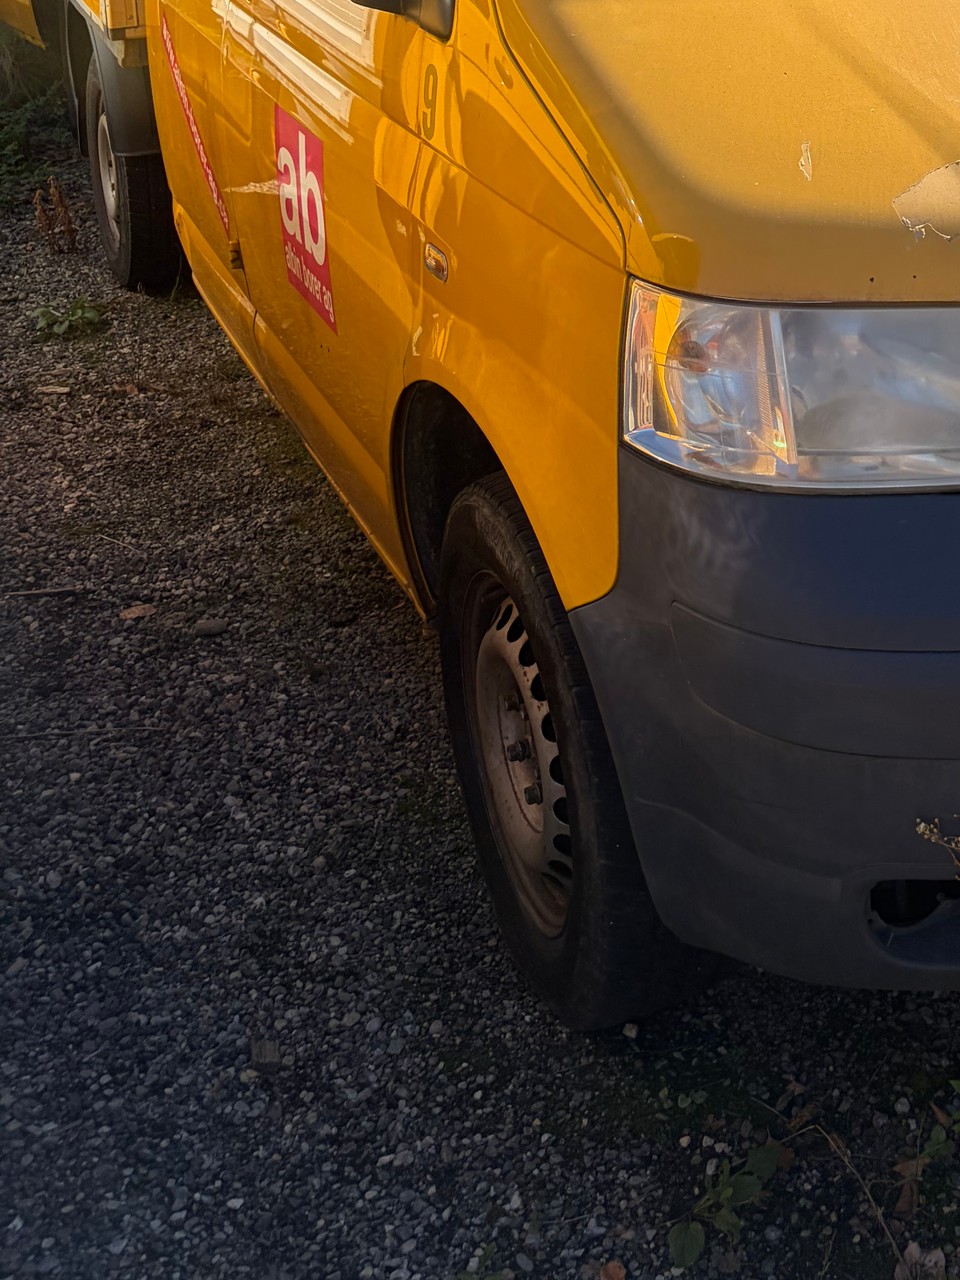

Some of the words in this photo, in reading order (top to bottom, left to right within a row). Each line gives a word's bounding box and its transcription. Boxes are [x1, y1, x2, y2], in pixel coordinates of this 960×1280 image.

[422, 63, 439, 141] 9
[277, 130, 326, 266] ab
[284, 243, 302, 283] albin
[301, 256, 323, 305] borer
[322, 285, 335, 323] ag
